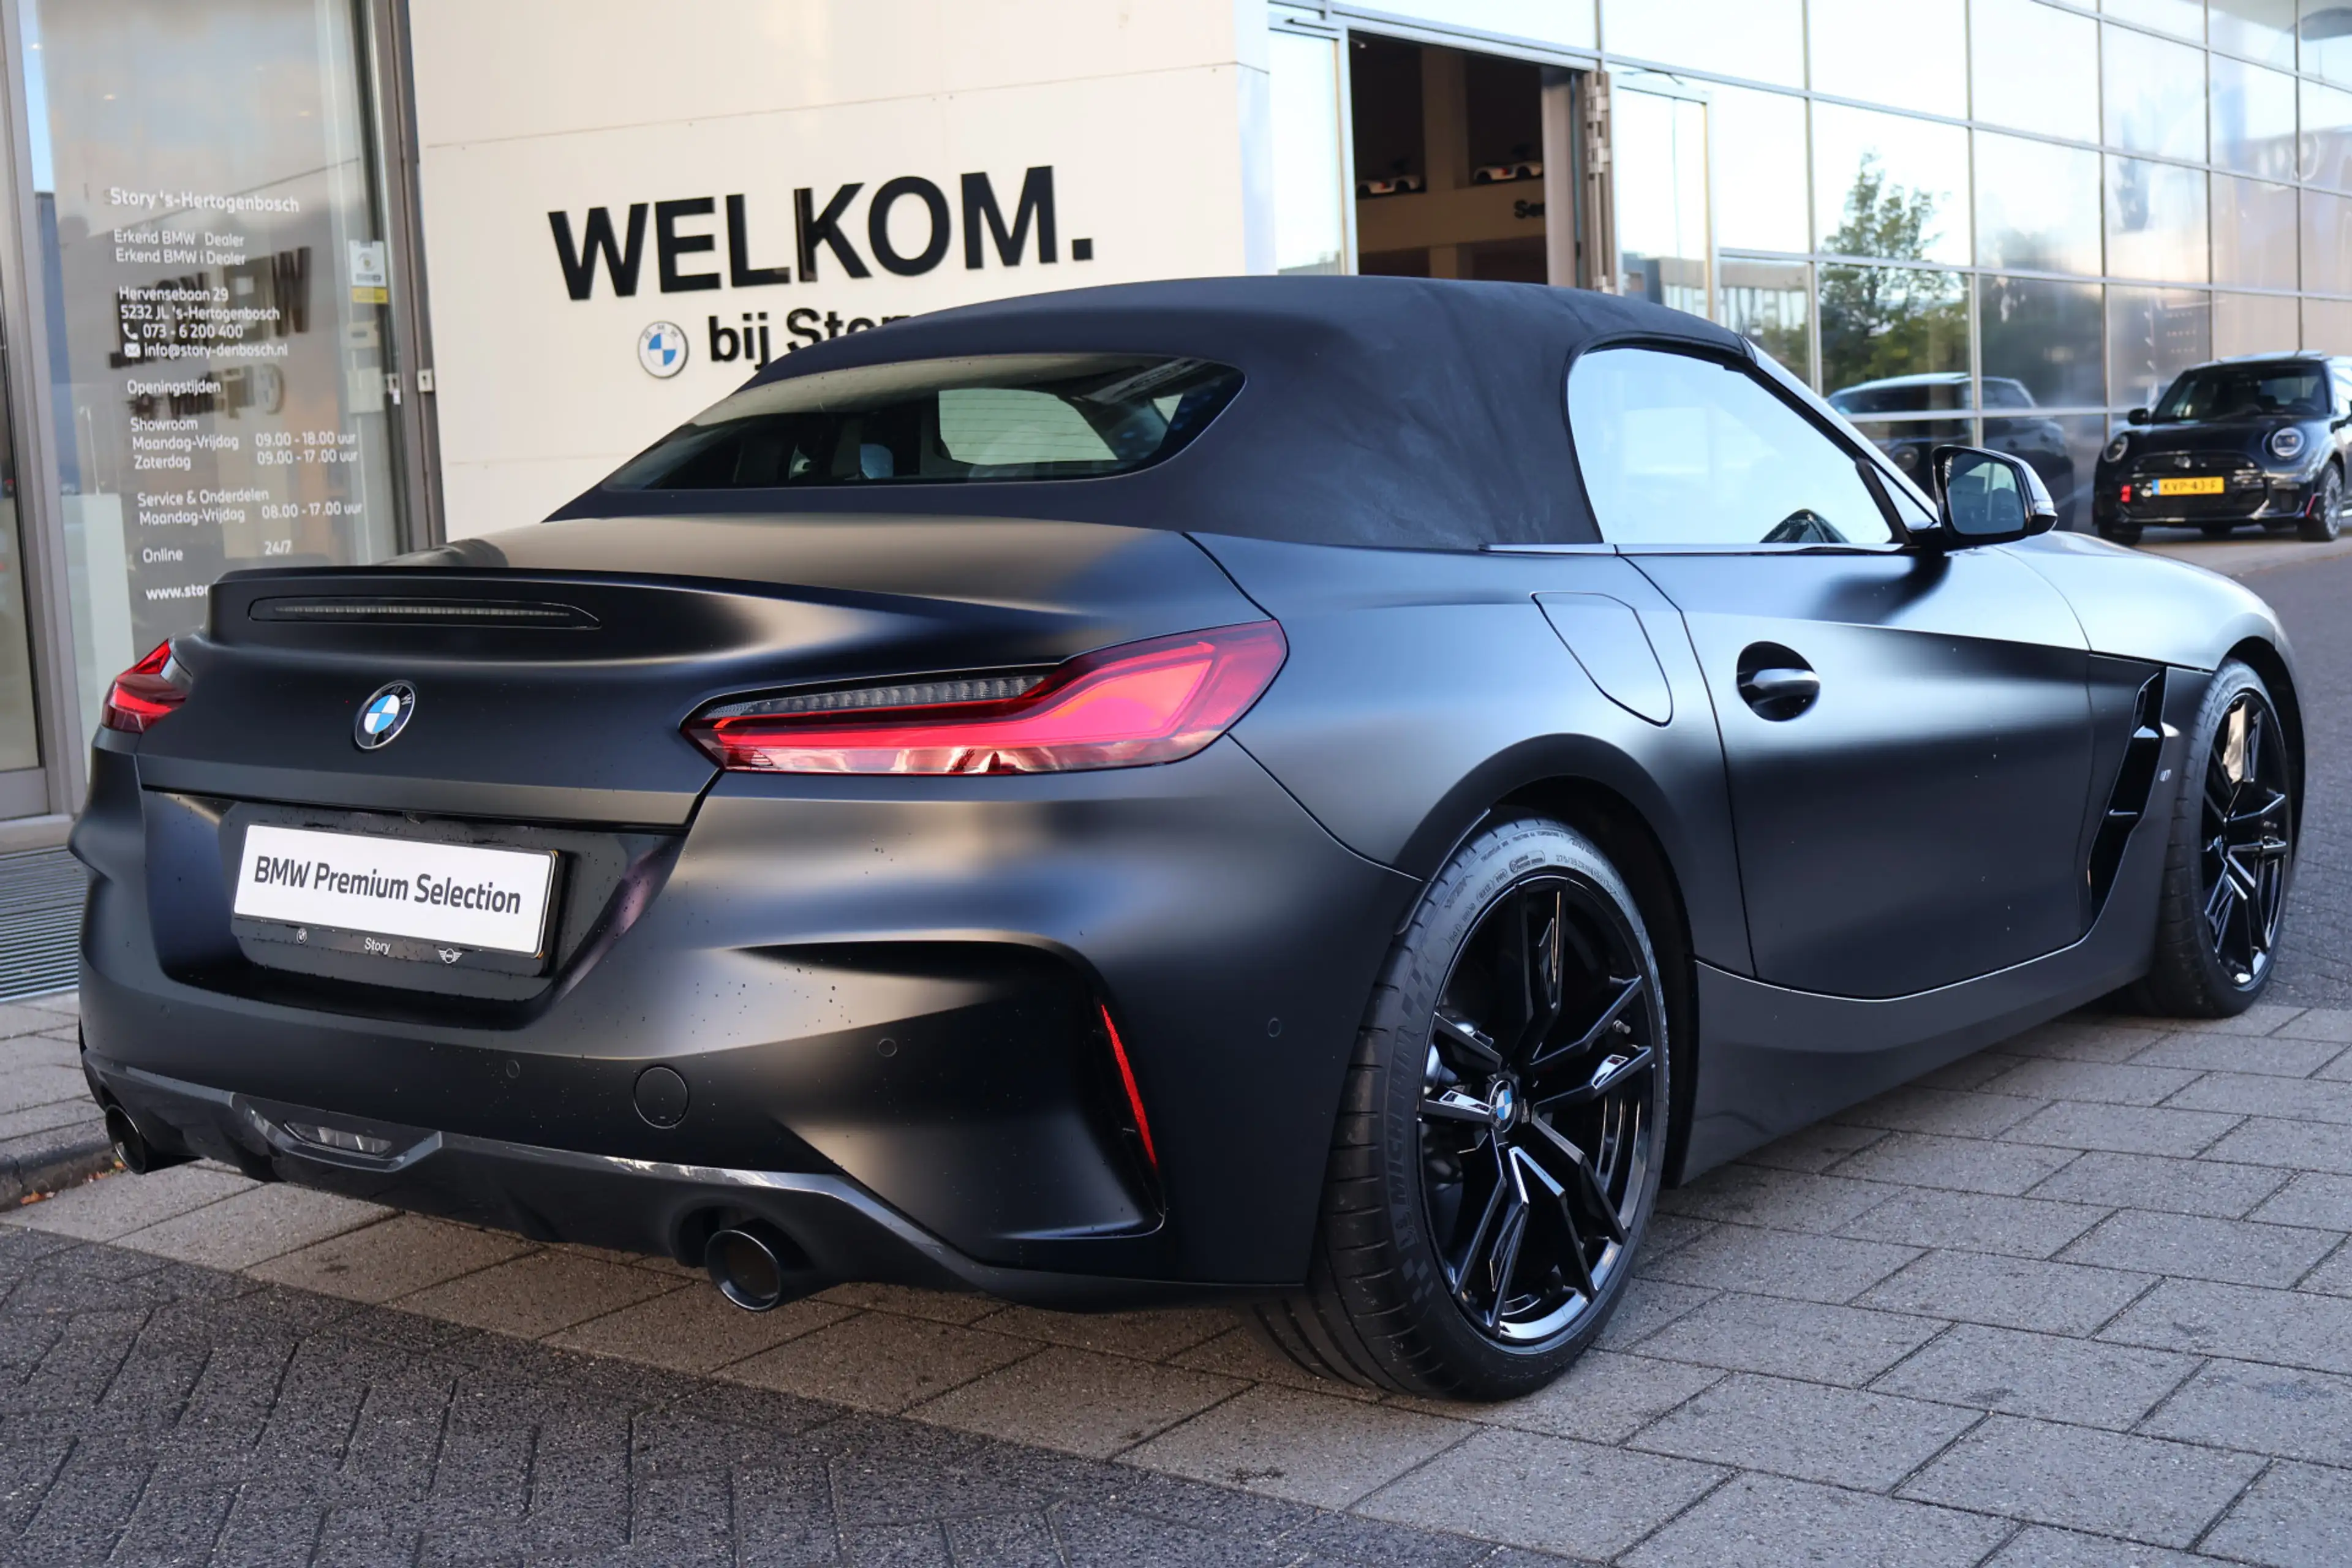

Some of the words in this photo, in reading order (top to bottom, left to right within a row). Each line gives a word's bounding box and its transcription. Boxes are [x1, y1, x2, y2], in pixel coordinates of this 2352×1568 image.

[110, 187, 156, 209] Story
[160, 189, 300, 213] 's-Hertogenbosch
[114, 229, 159, 245] Erkend
[162, 230, 196, 246] BMW
[205, 232, 245, 247] Dealer
[547, 165, 1093, 301] WELKOM.
[116, 247, 160, 263] Erkend
[164, 249, 197, 264] BMW
[200, 249, 203, 264] i
[206, 251, 246, 266] Dealer
[119, 286, 210, 302] Hervensebaan
[213, 287, 229, 303] 29
[121, 304, 153, 320] 5232
[155, 305, 170, 321] JL
[172, 305, 281, 323] 's-Hertogenbosch
[143, 324, 167, 338] 073
[179, 324, 187, 338] 6
[190, 324, 215, 338] 200
[218, 323, 244, 338] 400
[709, 311, 770, 371] bij
[145, 342, 288, 360] info@story-denbosch.nl
[127, 378, 221, 397] Openingstijden
[130, 417, 198, 432] Showroom
[132, 434, 239, 453] Maandag-Vrijdag
[255, 431, 292, 447] 09.00
[301, 431, 335, 446] 18.00
[337, 434, 356, 445] uur
[134, 453, 191, 471] Zaterdag
[257, 449, 293, 466] 09.00
[339, 451, 358, 463] uur
[137, 491, 184, 507] Service
[186, 489, 196, 504] &
[199, 488, 270, 504] Onderdelen
[139, 507, 245, 527] Maandag-Vrijdag
[262, 503, 298, 519] 08.00
[344, 502, 363, 514] uur
[142, 547, 184, 564] Online
[264, 538, 292, 556] 24/7
[254, 855, 311, 888] BMW
[314, 862, 409, 900] Premium
[414, 873, 521, 914] Selection
[364, 937, 392, 956] Story
